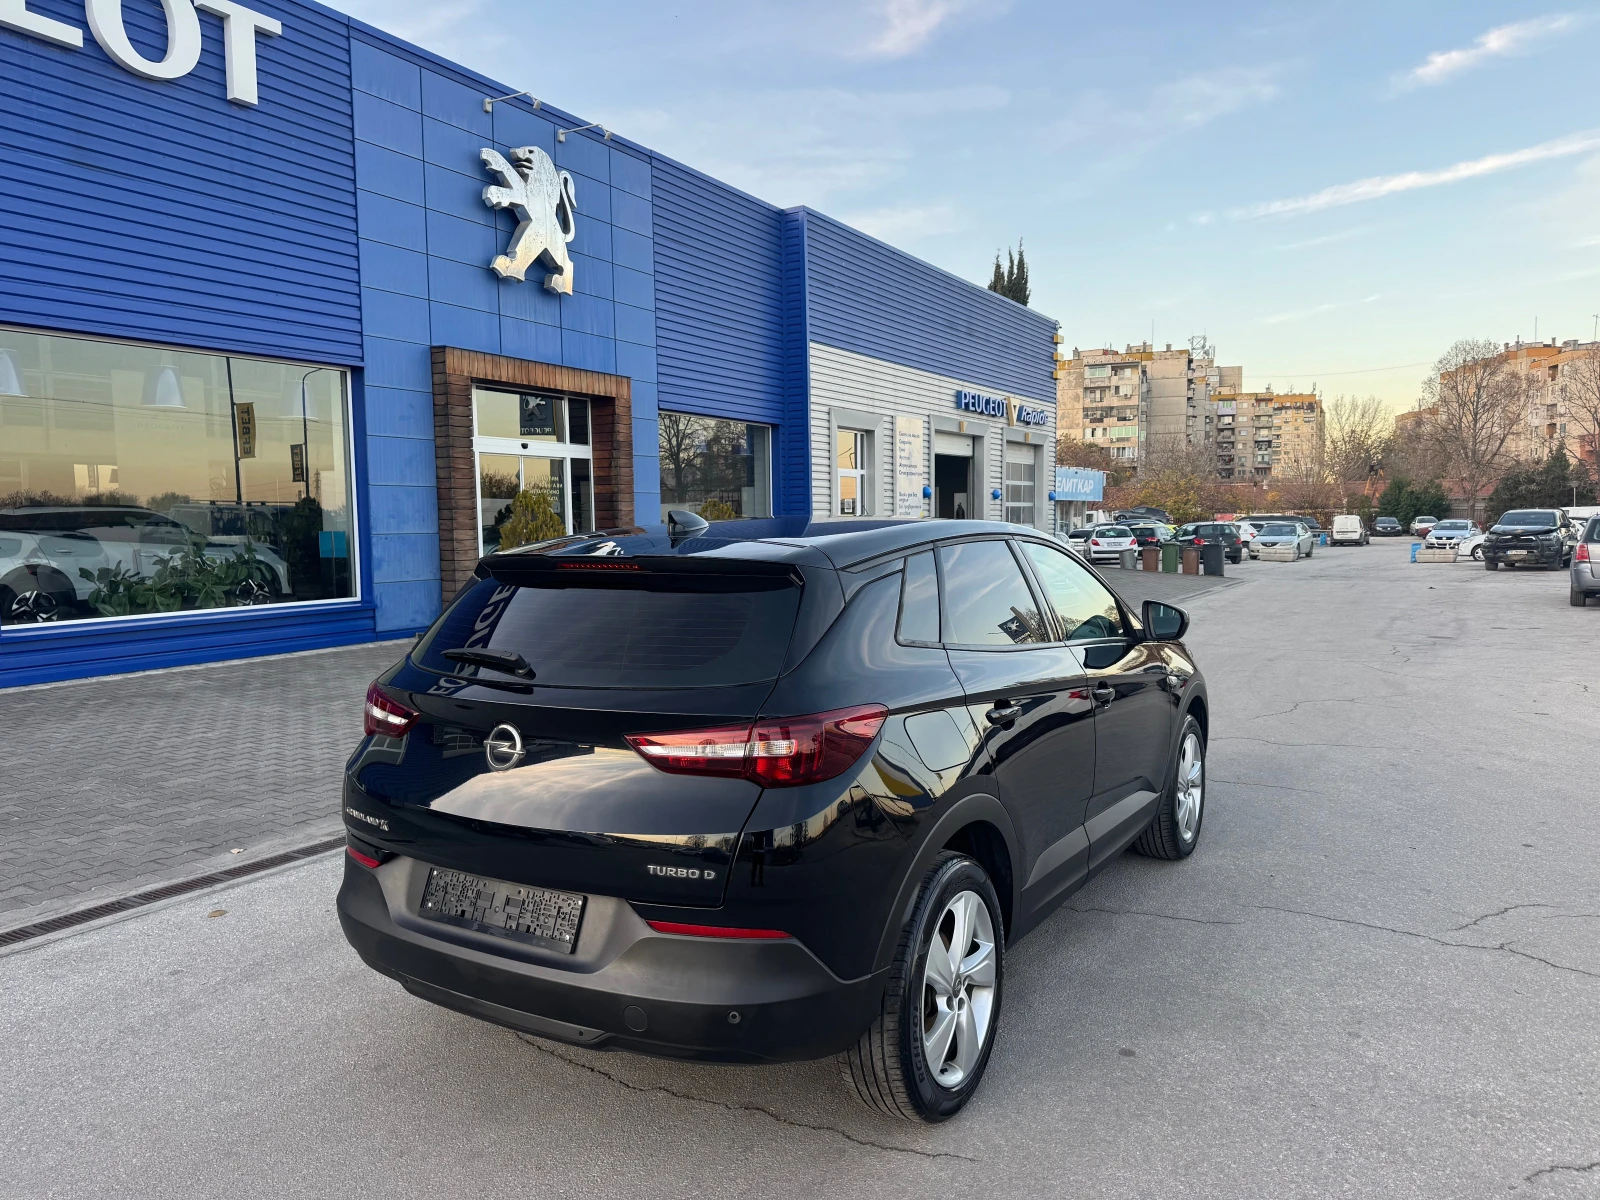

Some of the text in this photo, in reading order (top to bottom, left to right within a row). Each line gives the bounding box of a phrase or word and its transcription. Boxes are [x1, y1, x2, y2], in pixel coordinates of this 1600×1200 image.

[961, 390, 1007, 417] PEUGEOT
[647, 865, 716, 880] TURBO D
